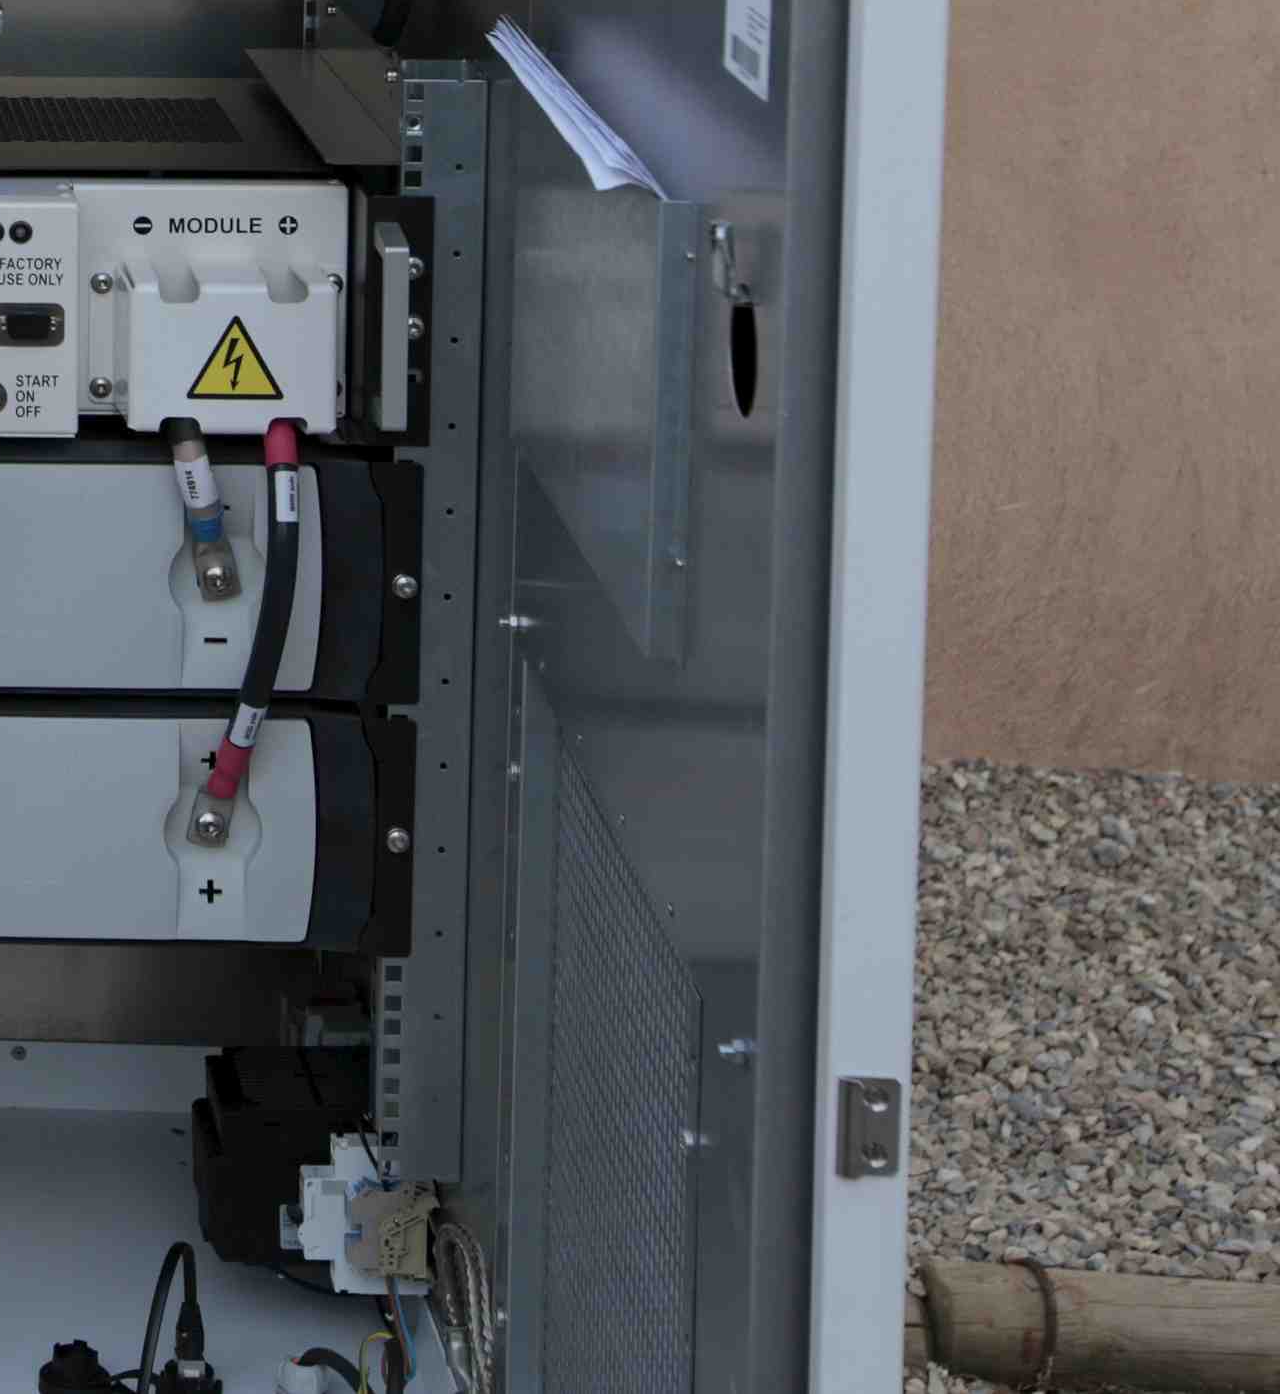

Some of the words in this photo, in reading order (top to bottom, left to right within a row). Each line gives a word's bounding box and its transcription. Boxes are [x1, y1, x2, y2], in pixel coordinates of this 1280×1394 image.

[168, 217, 263, 234] MODULE
[0, 257, 62, 271] FACTORY
[28, 273, 63, 286] ONLY
[15, 375, 59, 388] START
[15, 390, 35, 403] ON
[15, 405, 41, 418] OFF
